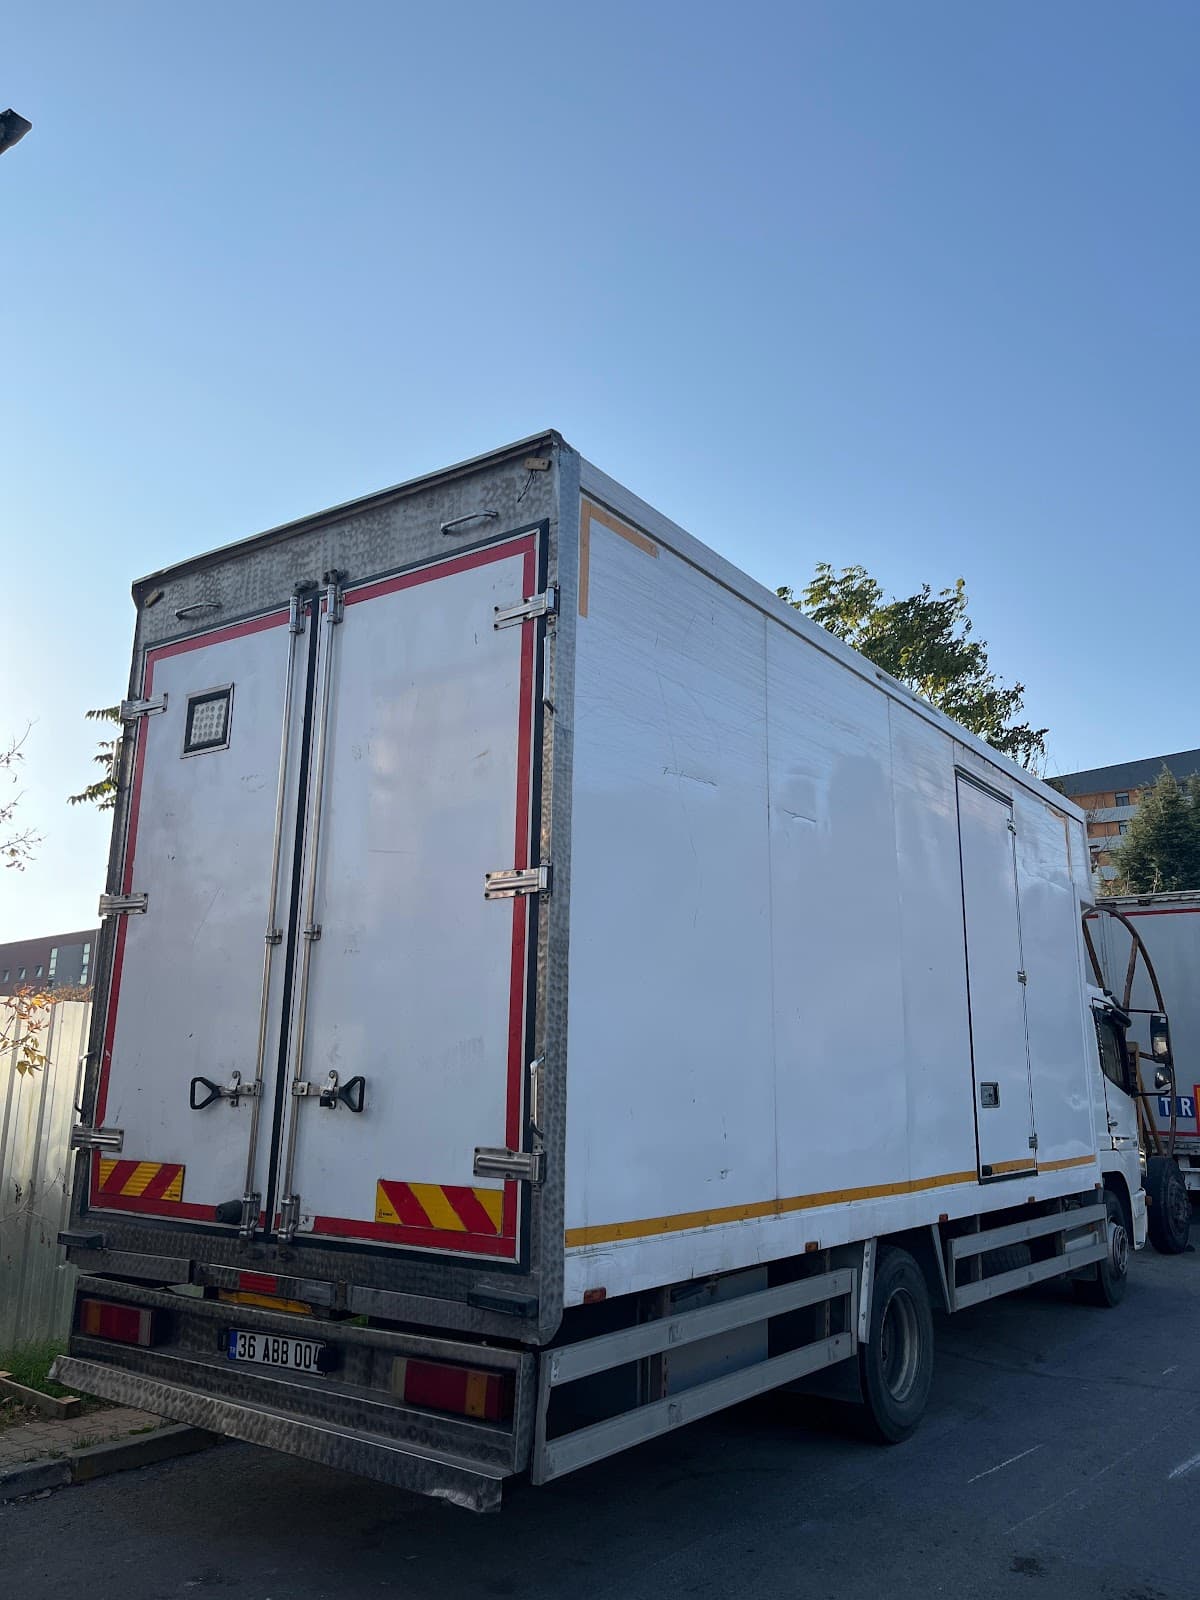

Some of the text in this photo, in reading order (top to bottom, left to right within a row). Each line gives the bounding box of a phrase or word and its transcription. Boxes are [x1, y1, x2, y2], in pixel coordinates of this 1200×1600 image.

[1160, 1097, 1193, 1117] TR
[238, 1334, 256, 1359] 36
[262, 1337, 289, 1365] ABB
